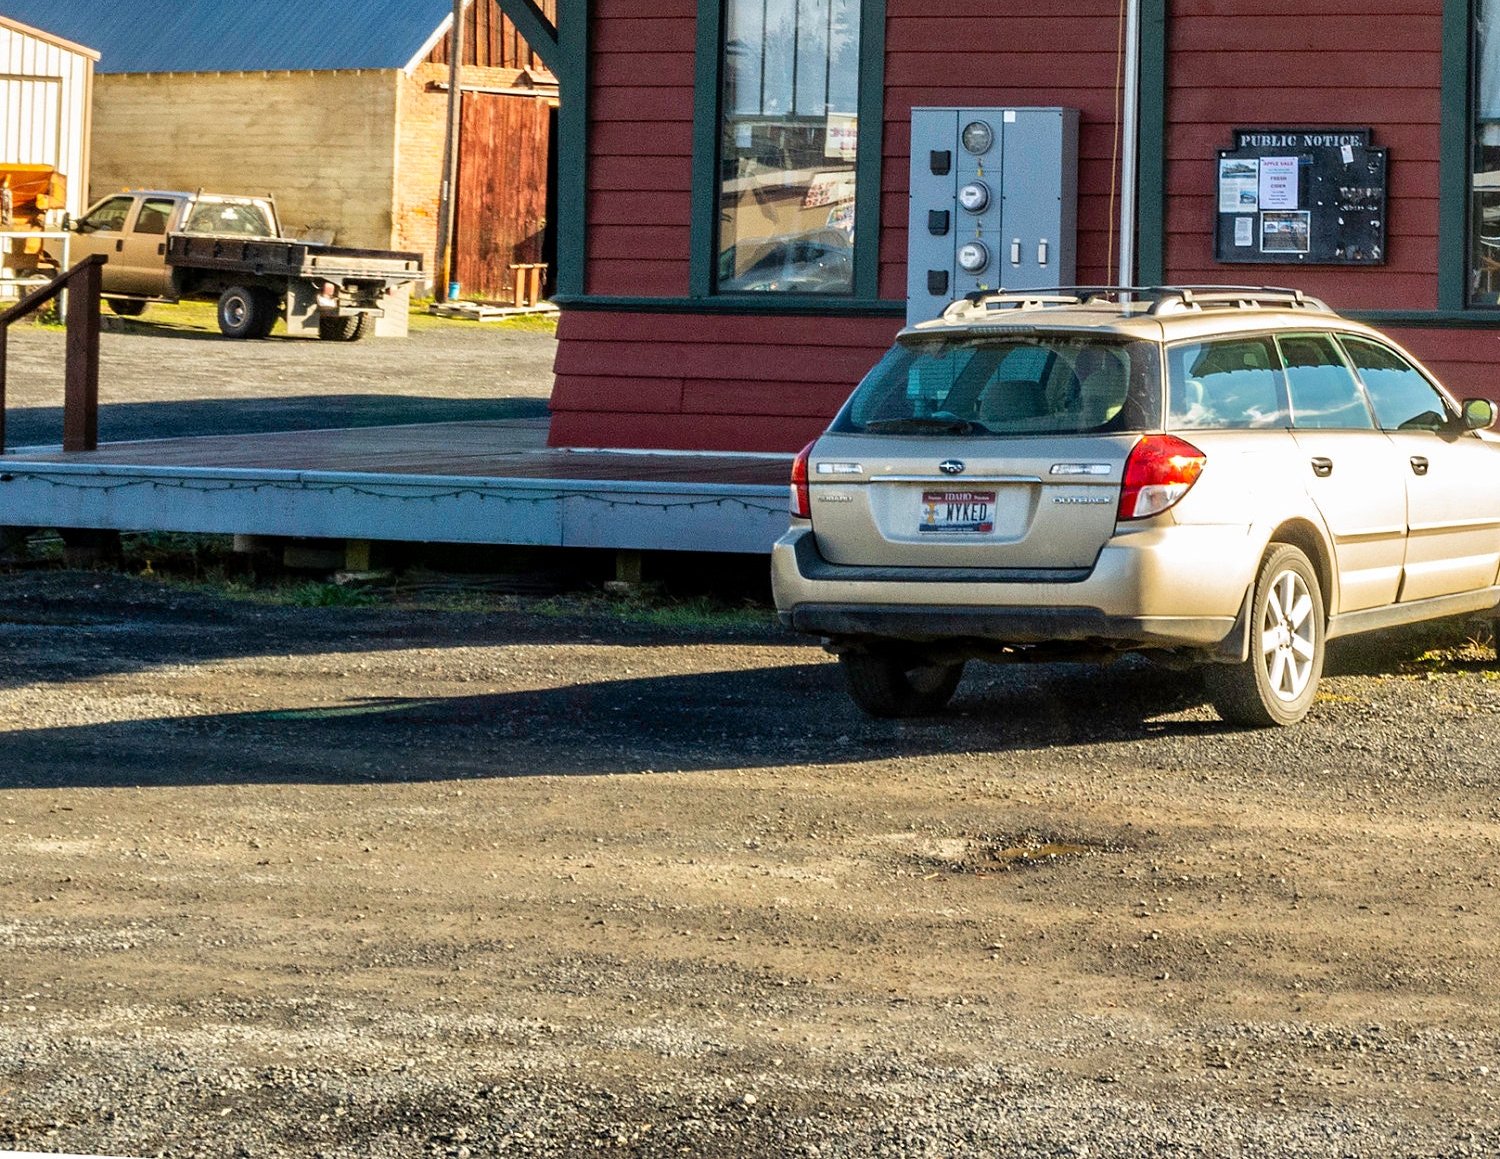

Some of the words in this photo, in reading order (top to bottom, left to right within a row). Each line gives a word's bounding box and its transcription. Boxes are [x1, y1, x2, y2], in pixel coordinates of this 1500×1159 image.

[1241, 135, 1297, 147] PUBLIC
[945, 492, 972, 501] IDAHO
[1052, 496, 1113, 505] OUTBACK
